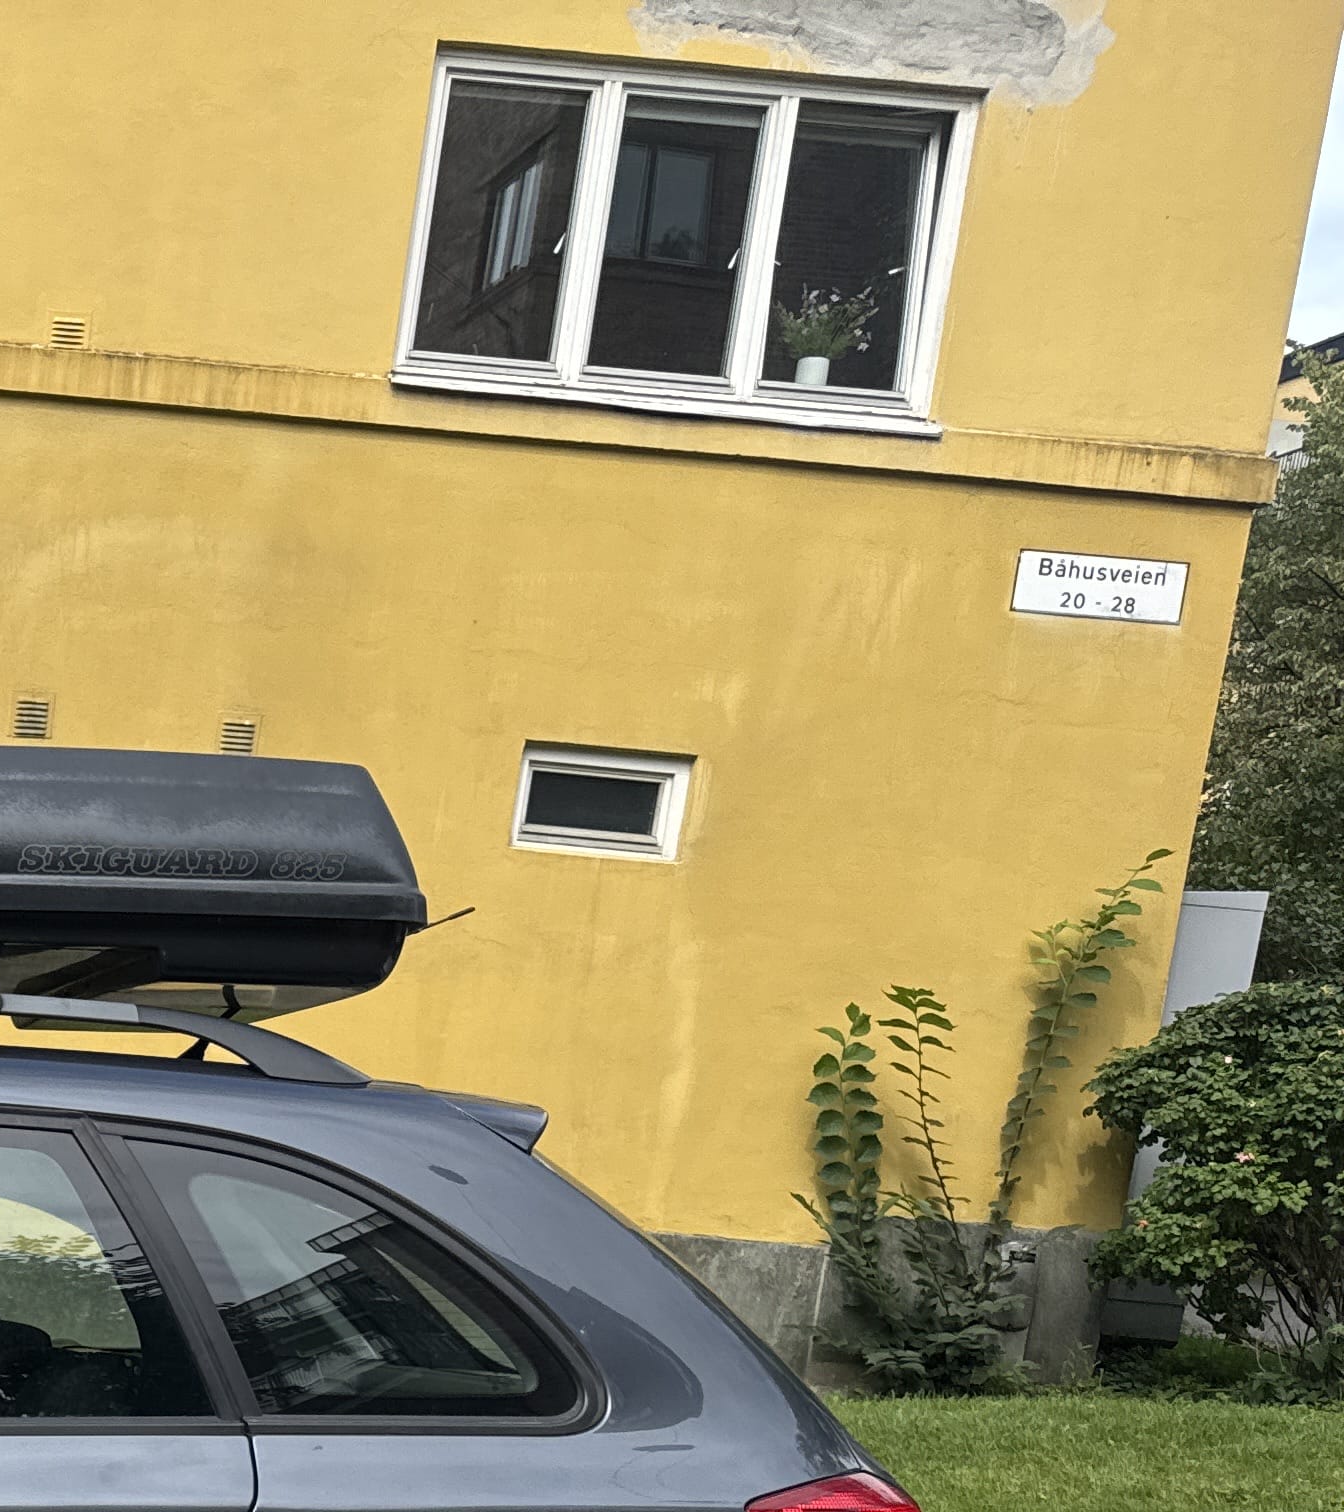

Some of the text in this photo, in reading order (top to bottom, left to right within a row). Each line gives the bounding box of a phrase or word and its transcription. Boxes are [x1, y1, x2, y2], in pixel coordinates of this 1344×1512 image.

[1038, 557, 1167, 587] Båhusveien
[1060, 591, 1086, 609] 20
[1111, 596, 1136, 614] 28
[18, 844, 348, 882] SKIGUARD 825
